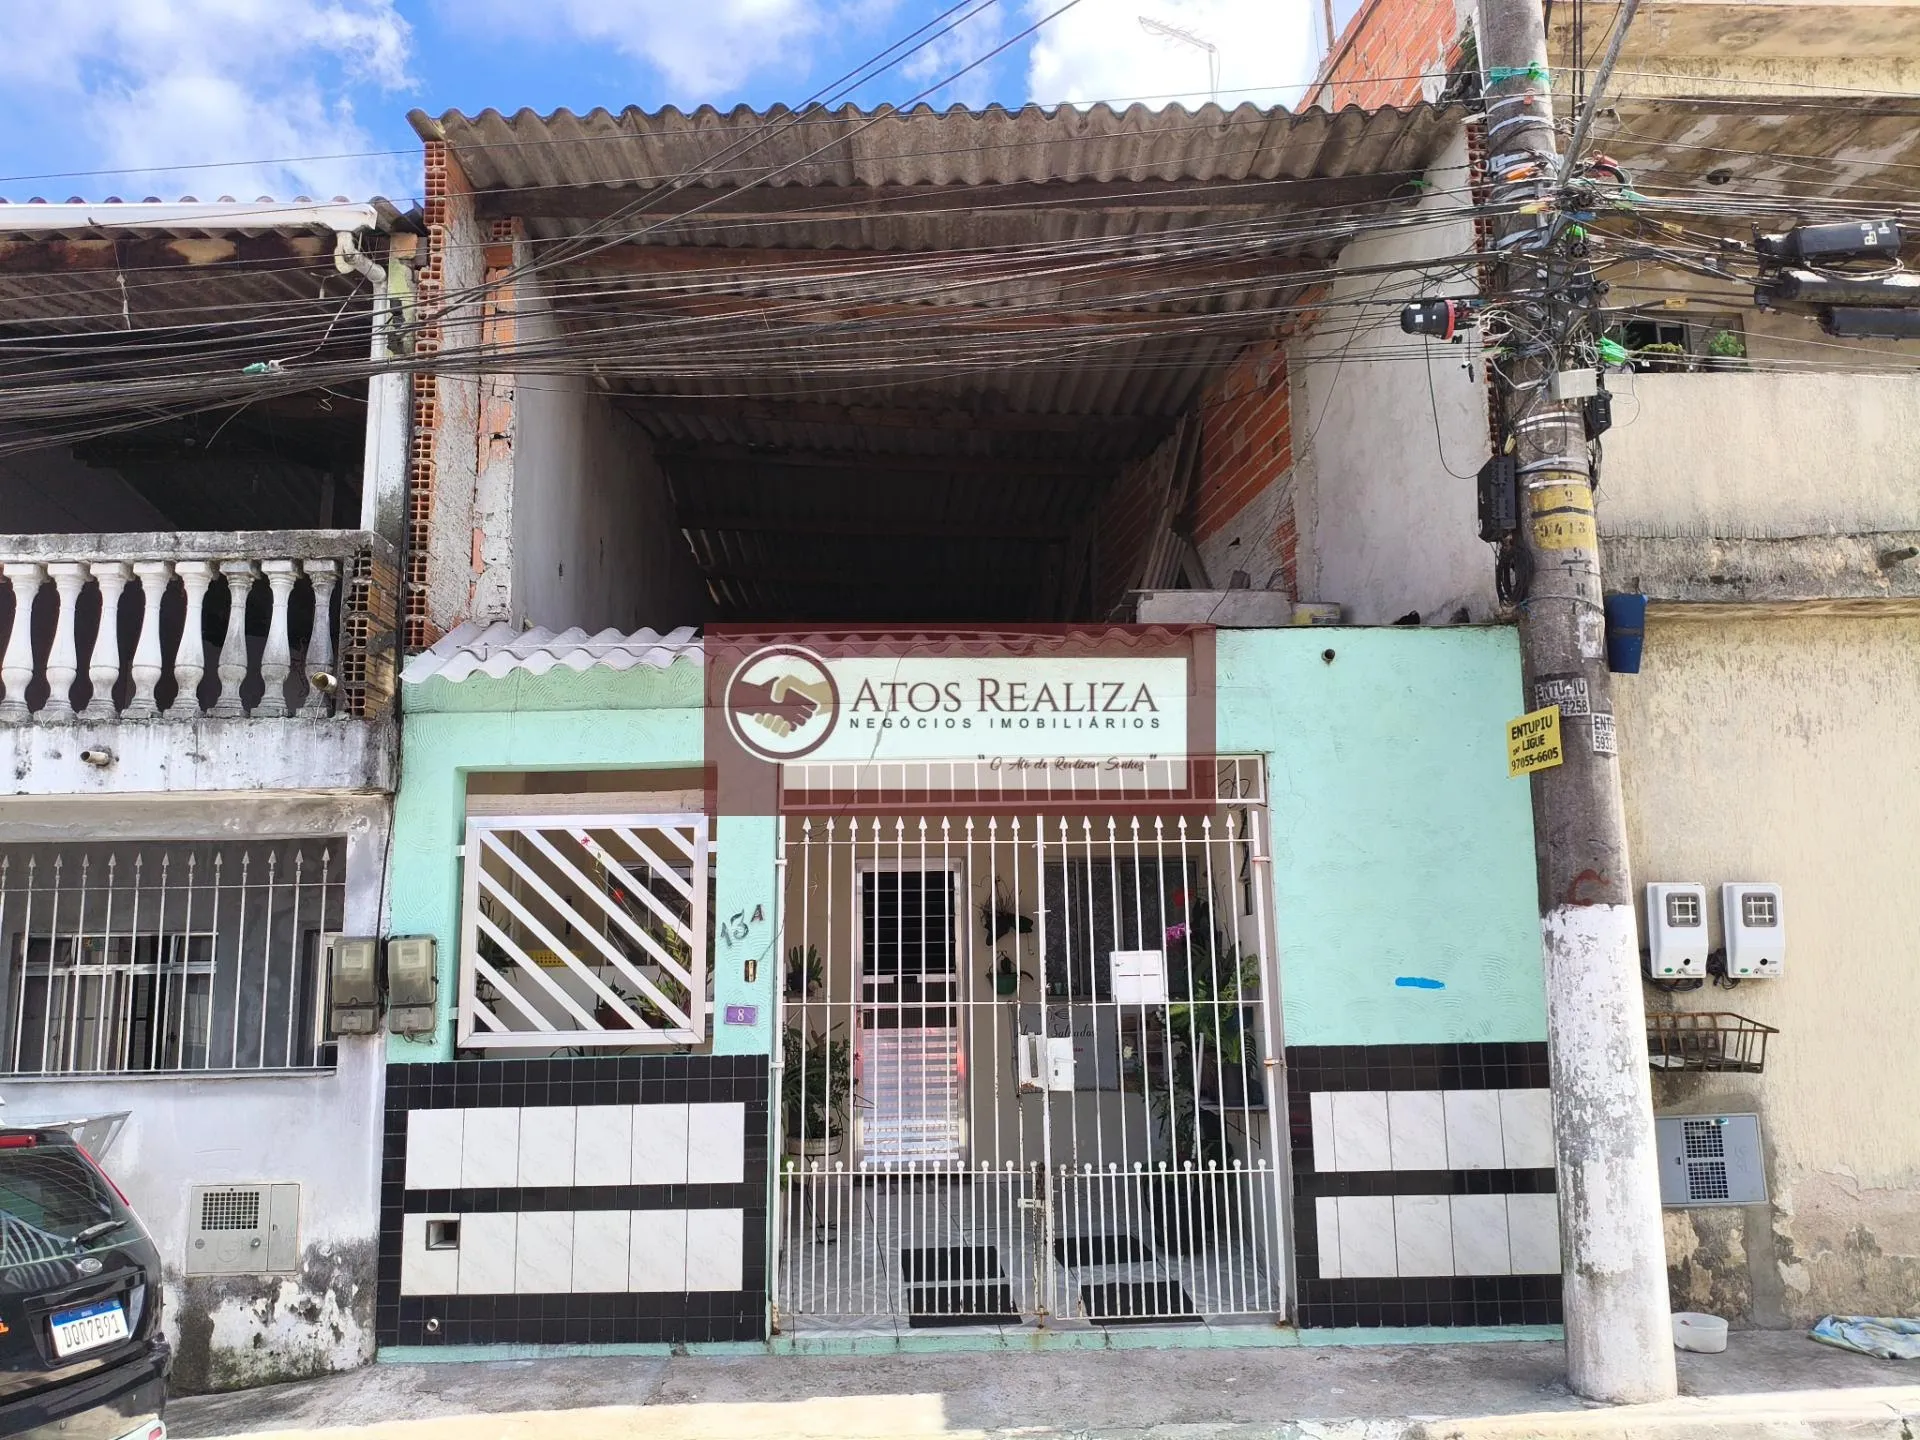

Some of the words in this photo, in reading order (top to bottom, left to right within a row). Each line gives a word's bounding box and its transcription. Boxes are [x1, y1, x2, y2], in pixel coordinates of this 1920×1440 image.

[1511, 714, 1553, 740] ENTUPIU
[1522, 734, 1546, 751] LIGUE
[1511, 747, 1559, 772] 97055-6605
[736, 1008, 745, 1021] 8
[62, 1313, 120, 1348] DQR7B91
